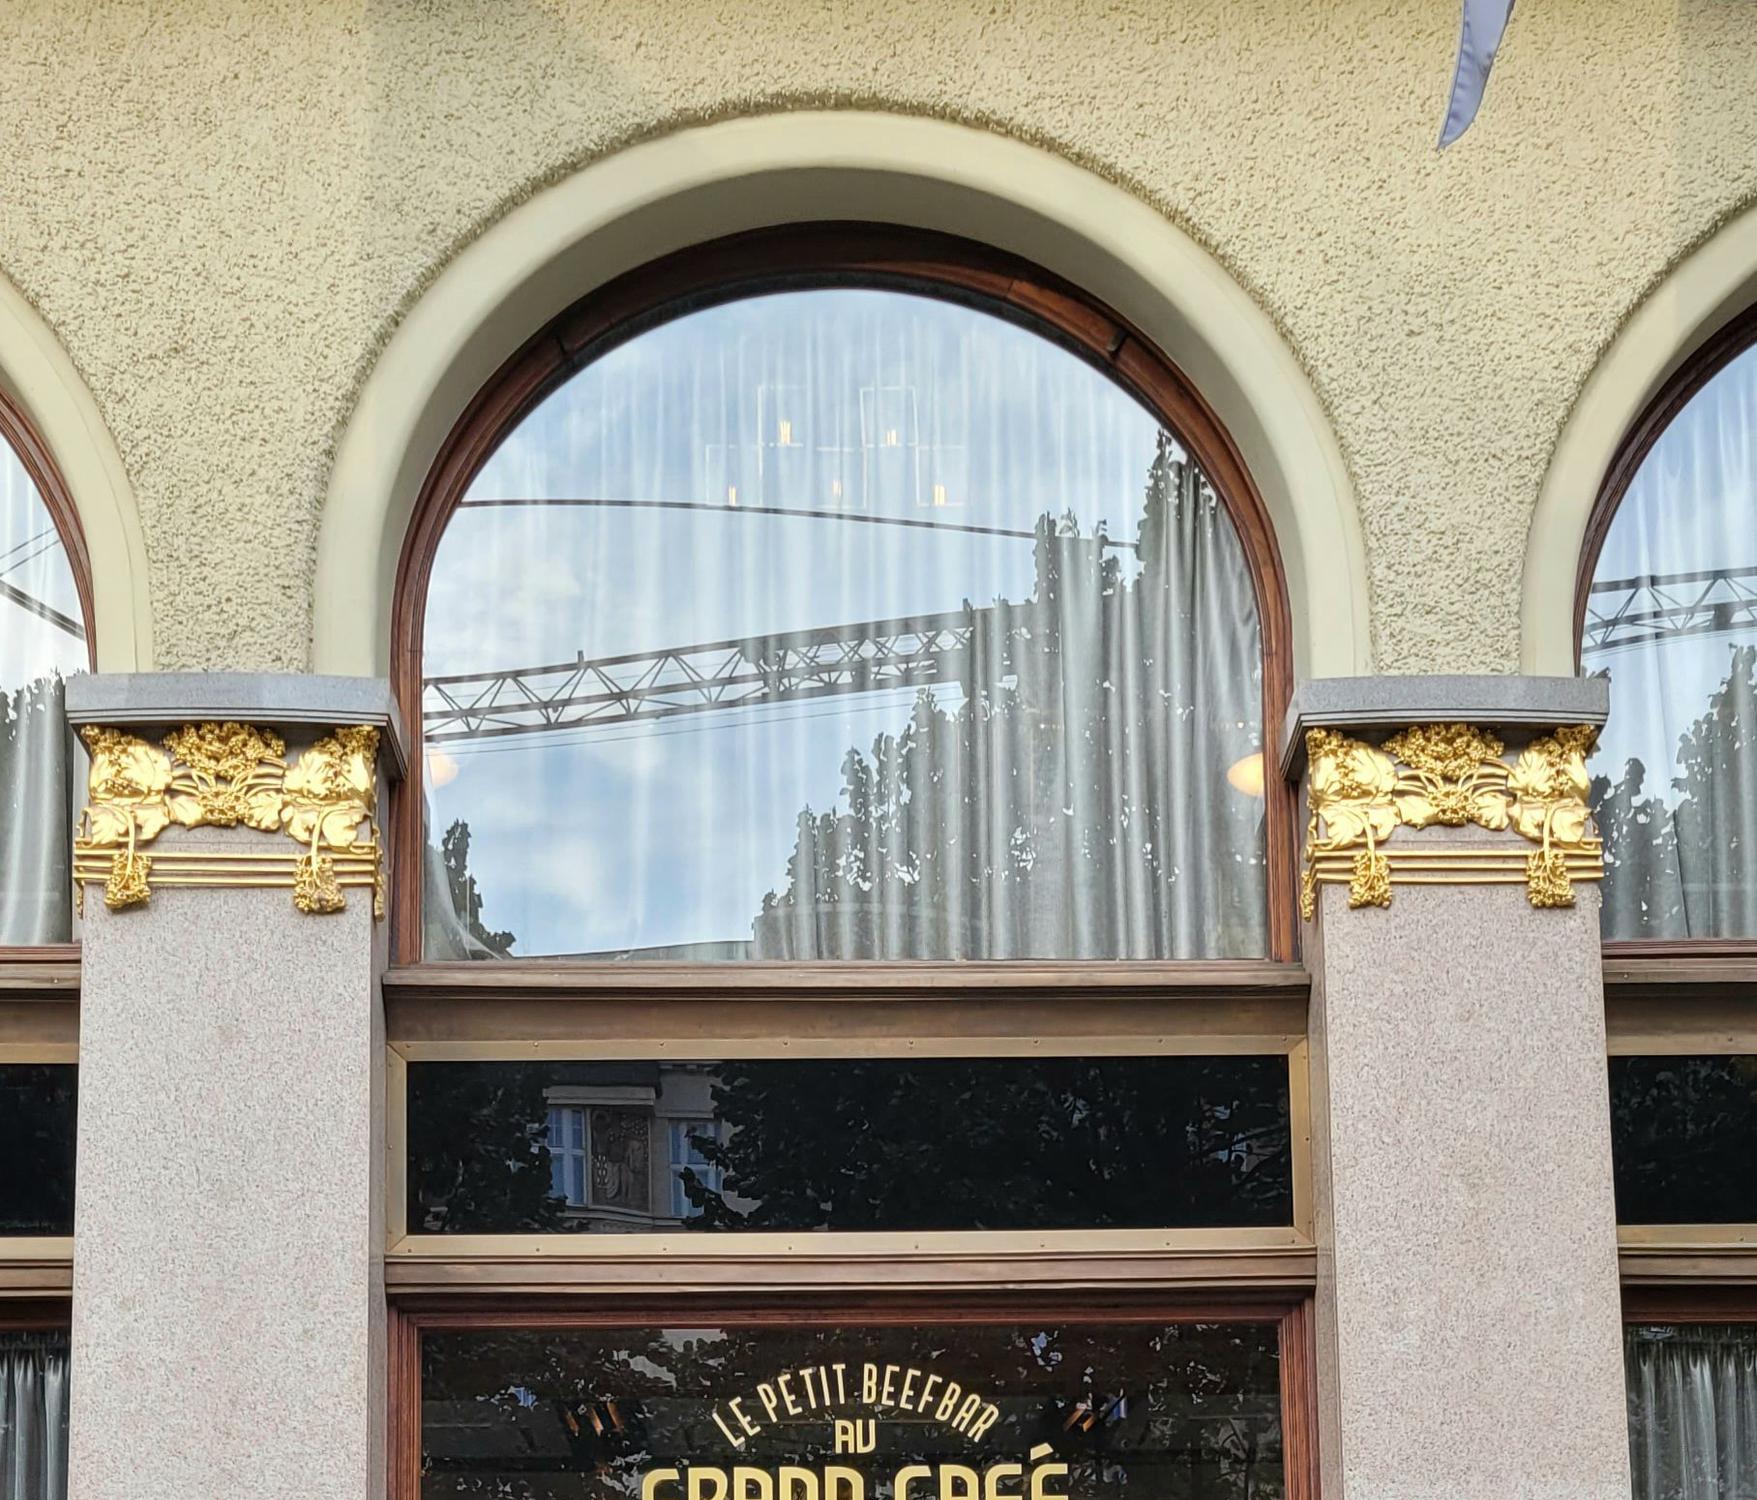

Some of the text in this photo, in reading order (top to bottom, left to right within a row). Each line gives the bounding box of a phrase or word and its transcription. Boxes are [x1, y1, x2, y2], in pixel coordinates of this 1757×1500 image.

[711, 1363, 1000, 1447] LE PETIT BEEFBAR
[835, 1419, 877, 1454] AU
